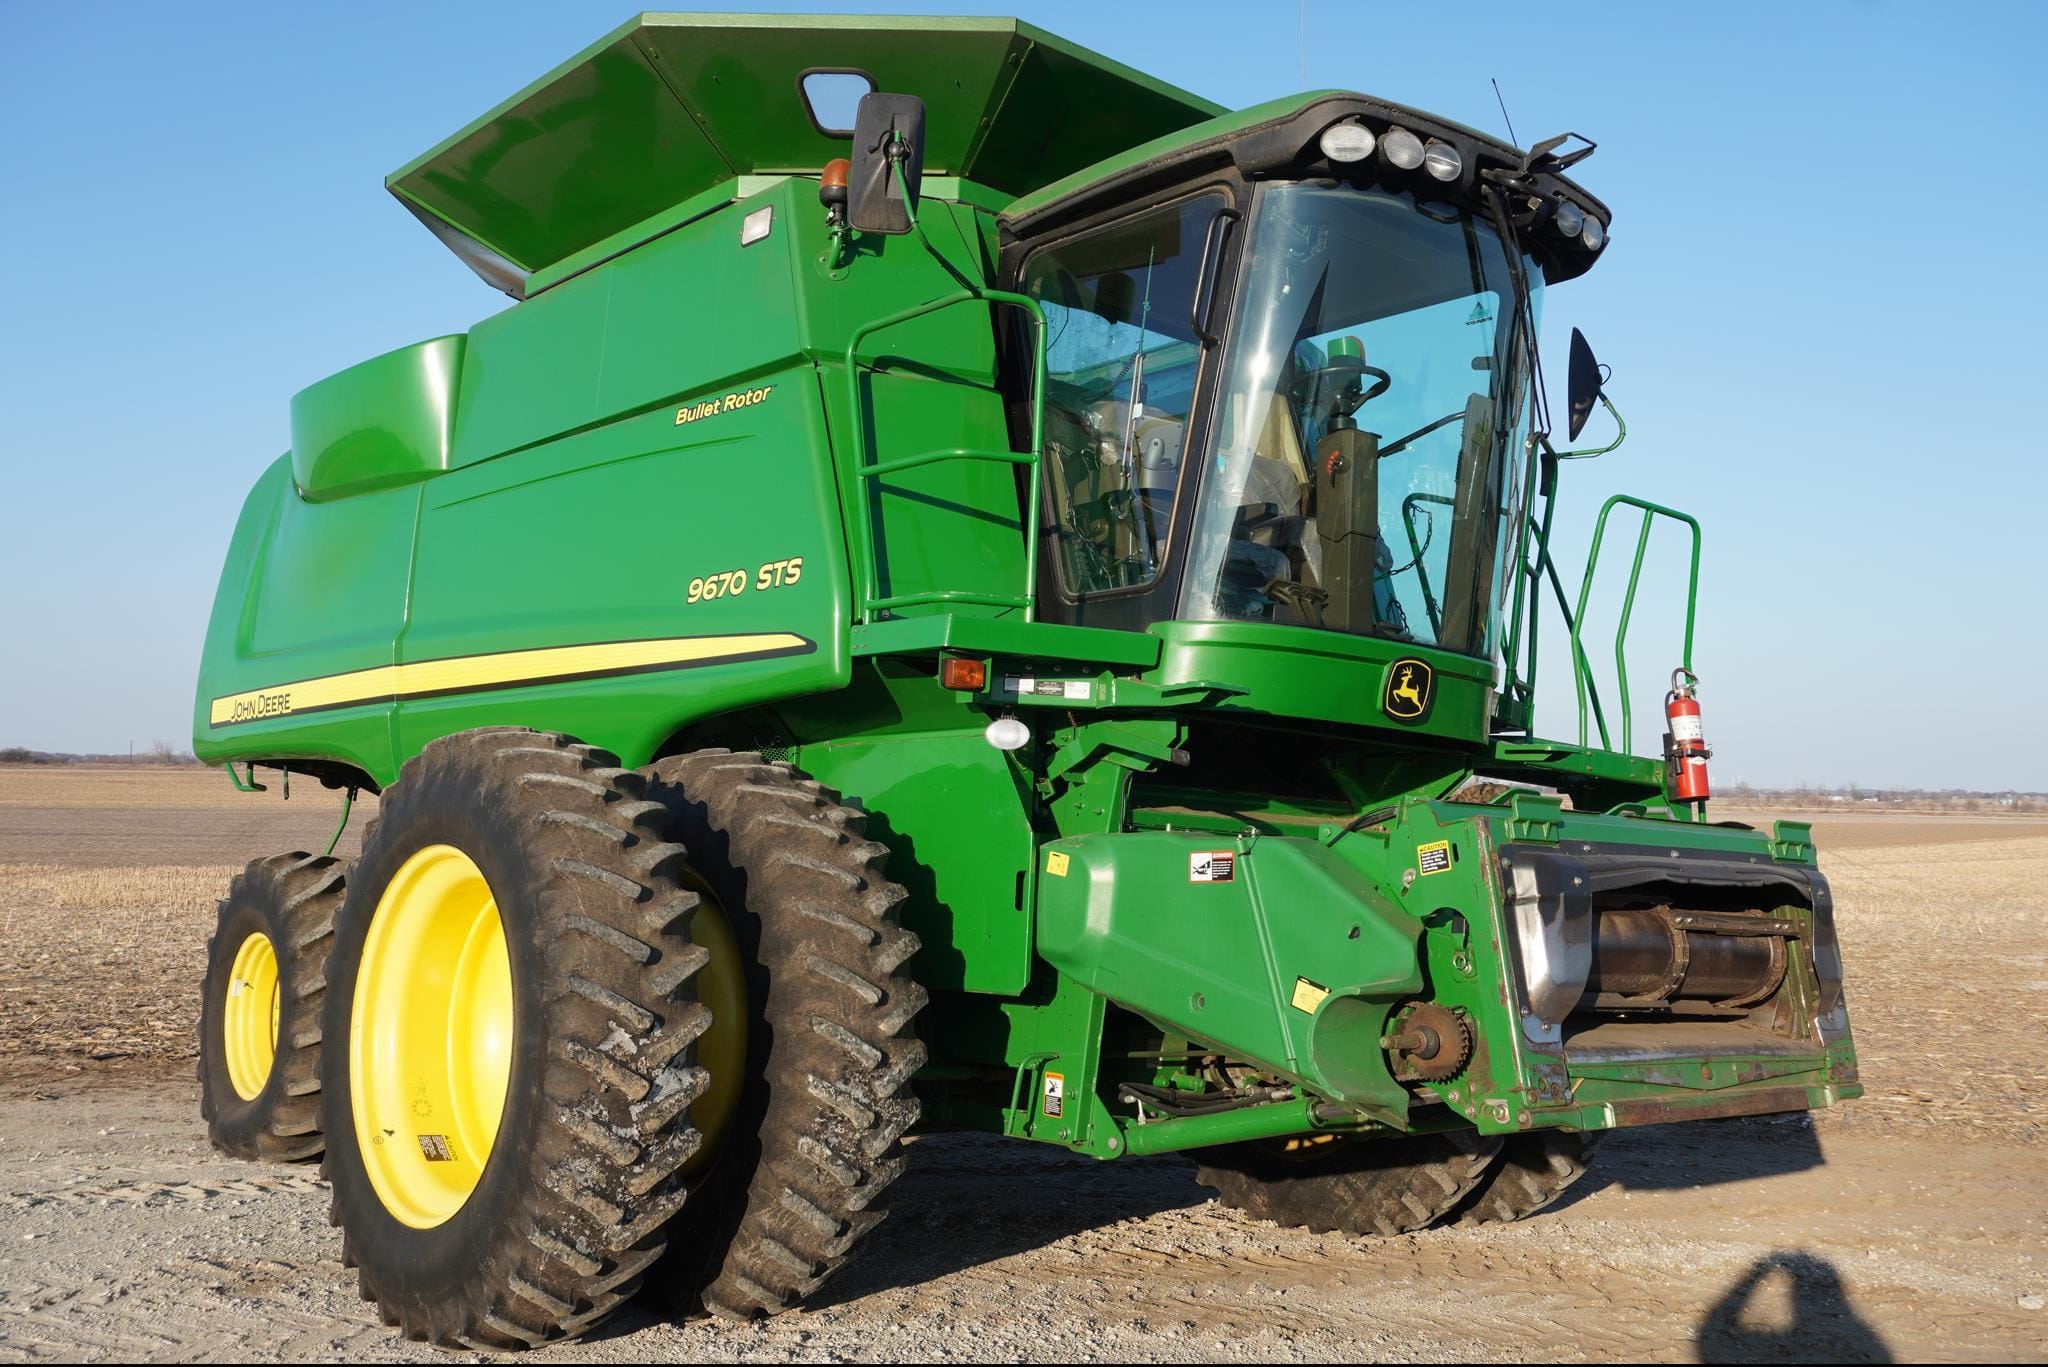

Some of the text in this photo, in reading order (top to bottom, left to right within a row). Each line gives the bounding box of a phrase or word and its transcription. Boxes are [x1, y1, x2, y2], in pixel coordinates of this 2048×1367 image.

[674, 385, 772, 426] Bullet Rotor
[687, 557, 803, 604] 9670 STS
[230, 694, 291, 720] JOHN DEERE
